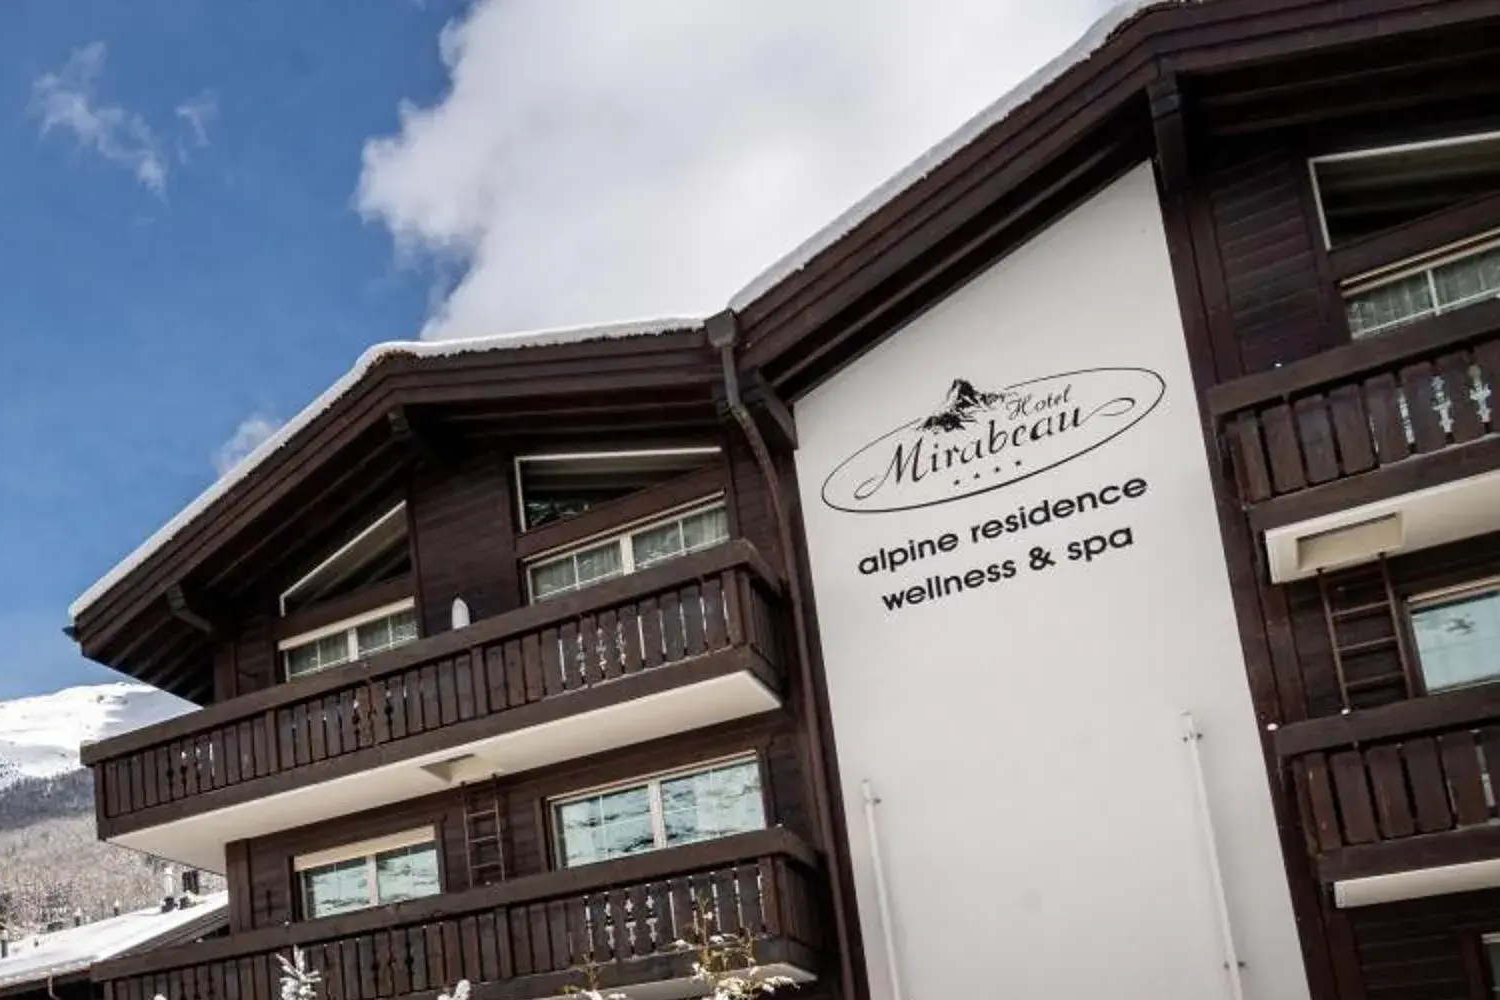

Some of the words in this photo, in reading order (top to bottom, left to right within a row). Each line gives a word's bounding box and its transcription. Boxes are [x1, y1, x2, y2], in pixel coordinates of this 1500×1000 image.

[1008, 383, 1073, 420] Hotel
[855, 402, 1102, 499] Mirabeau
[857, 531, 960, 576] alpine
[970, 477, 1149, 544] residence
[881, 559, 1018, 612] wellness
[1028, 545, 1057, 572] &
[1066, 527, 1134, 563] spa
